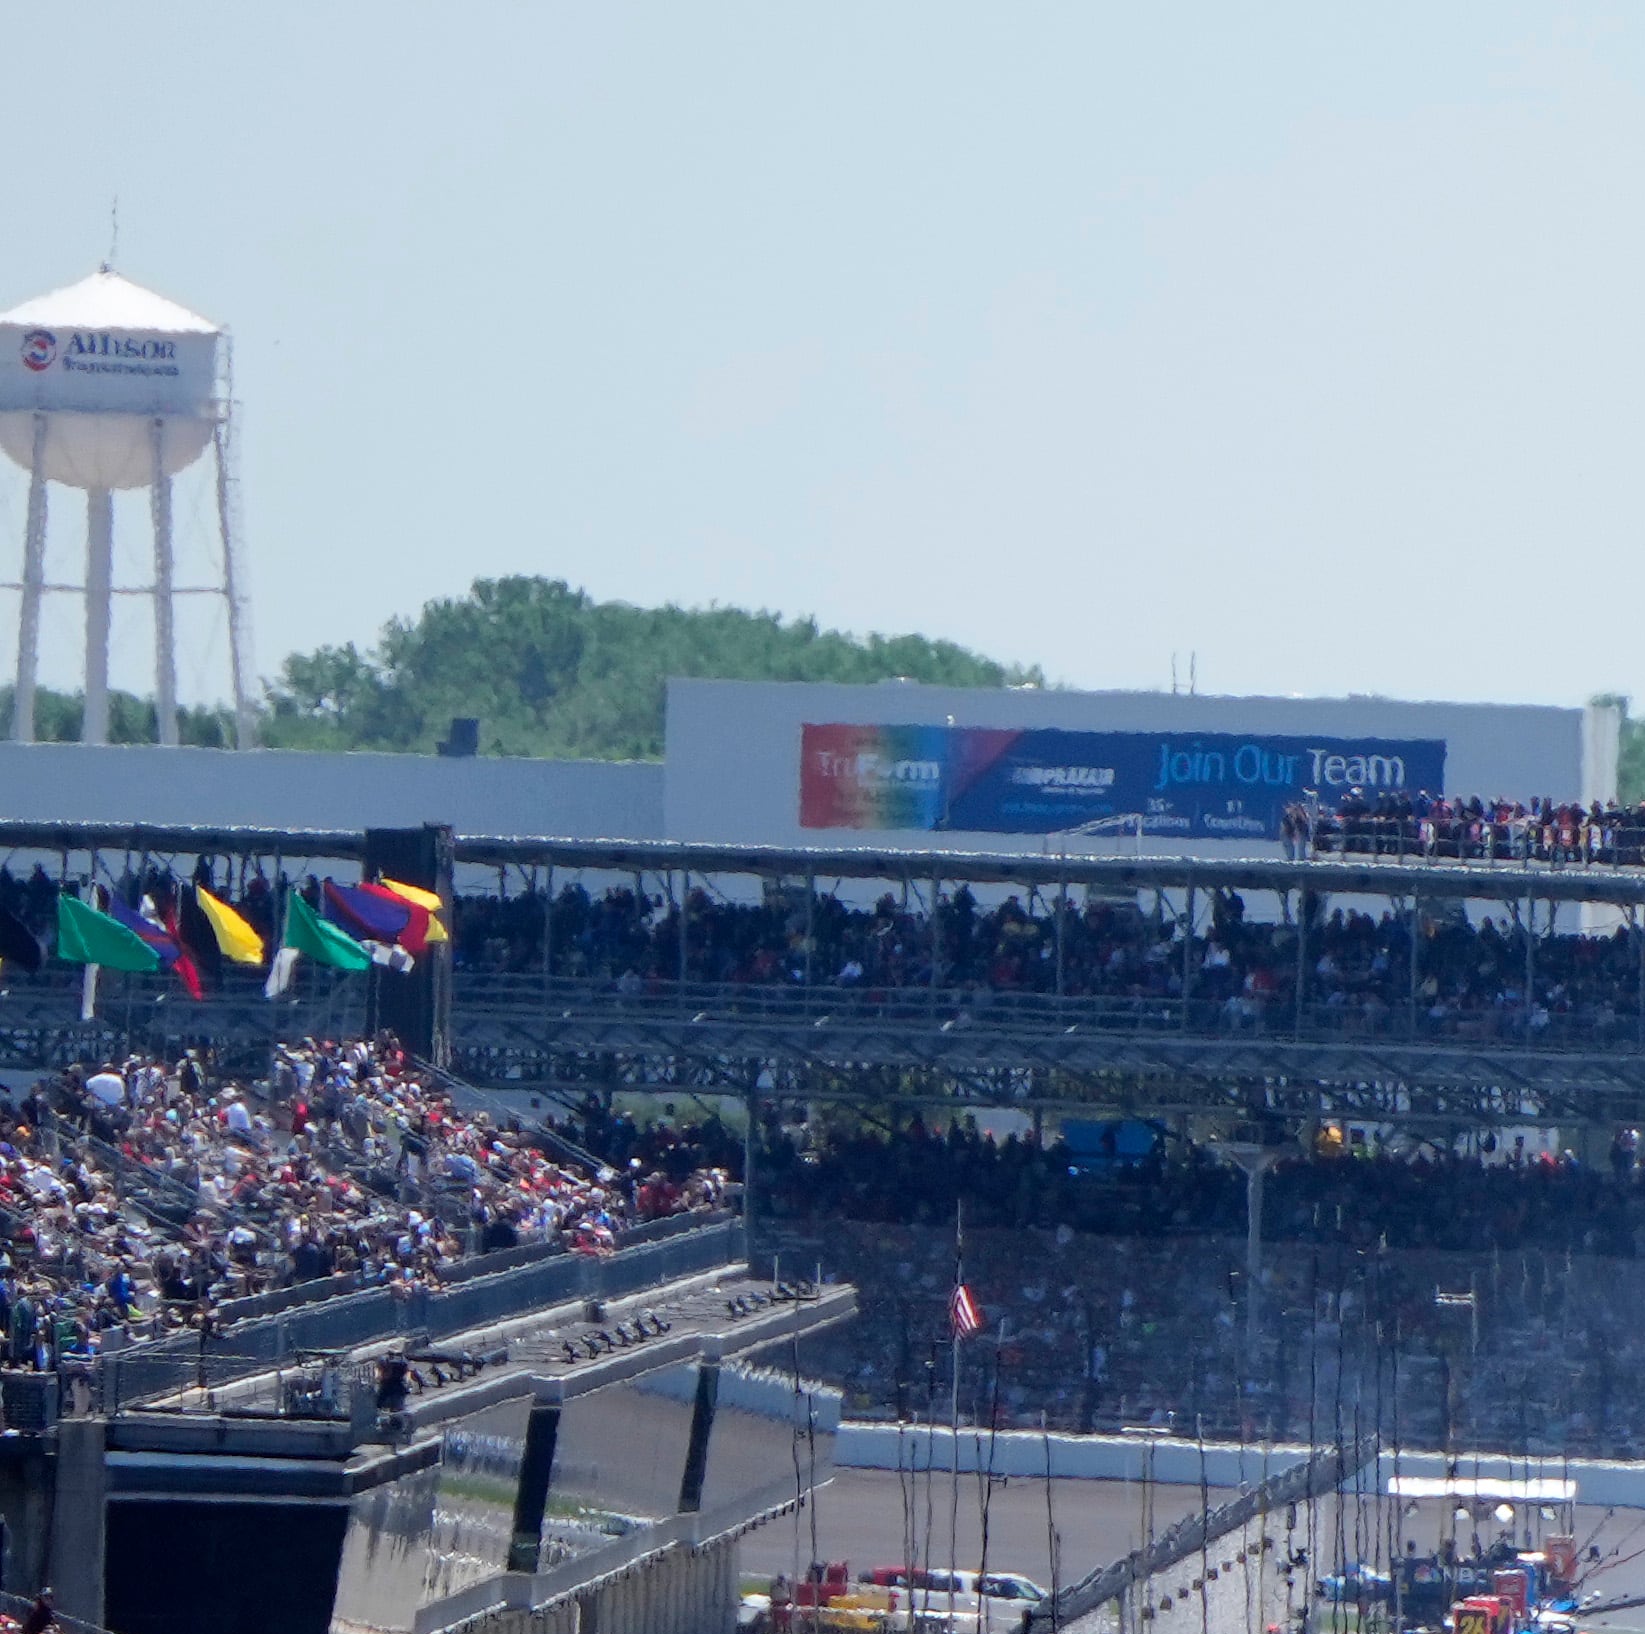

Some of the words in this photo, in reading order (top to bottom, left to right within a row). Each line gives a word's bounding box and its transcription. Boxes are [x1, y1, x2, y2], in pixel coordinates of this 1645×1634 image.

[67, 332, 177, 360] Allison
[1154, 742, 1225, 790] Join
[1233, 744, 1299, 785] Our
[1307, 749, 1406, 786] Team
